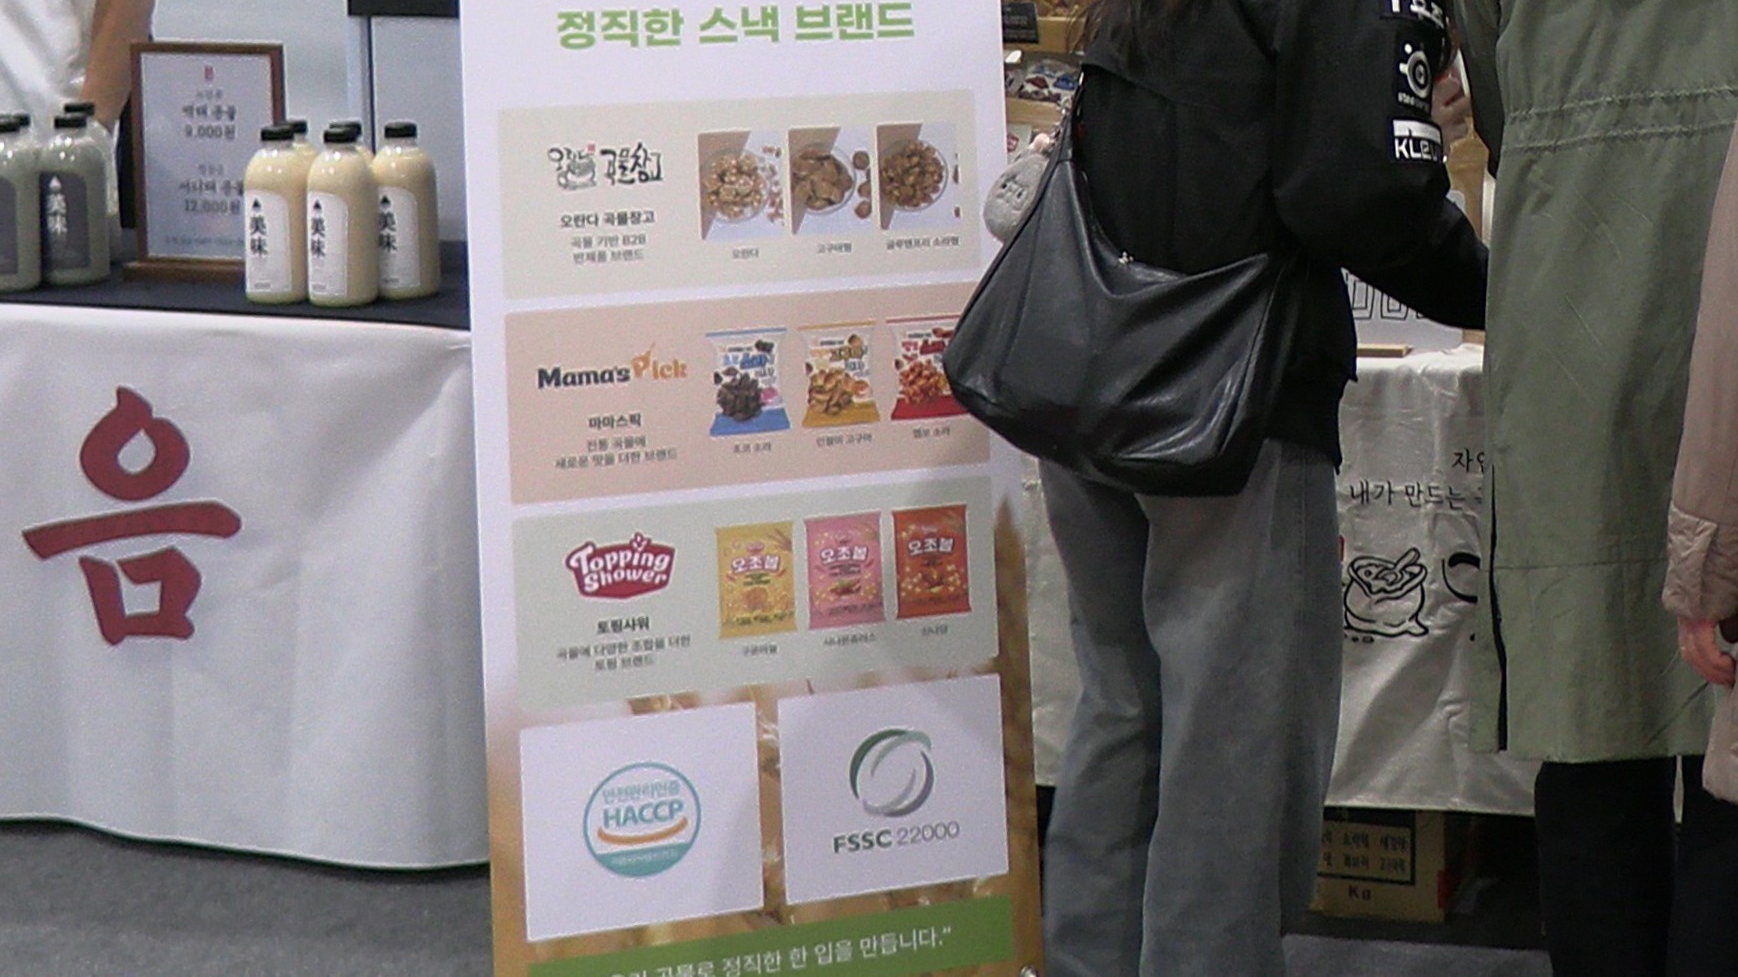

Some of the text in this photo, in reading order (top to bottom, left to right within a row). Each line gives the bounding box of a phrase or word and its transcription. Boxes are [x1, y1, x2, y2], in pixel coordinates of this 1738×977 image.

[556, 2, 916, 51] 정직한 스낵 브랜드
[560, 213, 599, 229] 오란다
[622, 234, 647, 245] B2B
[537, 366, 631, 390] Mama's
[631, 353, 689, 381] Pick
[1349, 479, 1467, 512] 내가 만드는
[21, 384, 242, 646] 음
[568, 544, 671, 575] Topping
[583, 565, 668, 593] Shower
[602, 799, 684, 829] HACCP
[832, 820, 961, 855] FSSC 22000
[721, 951, 783, 977] 정직한
[788, 947, 808, 969] 한
[813, 941, 853, 966] 입을
